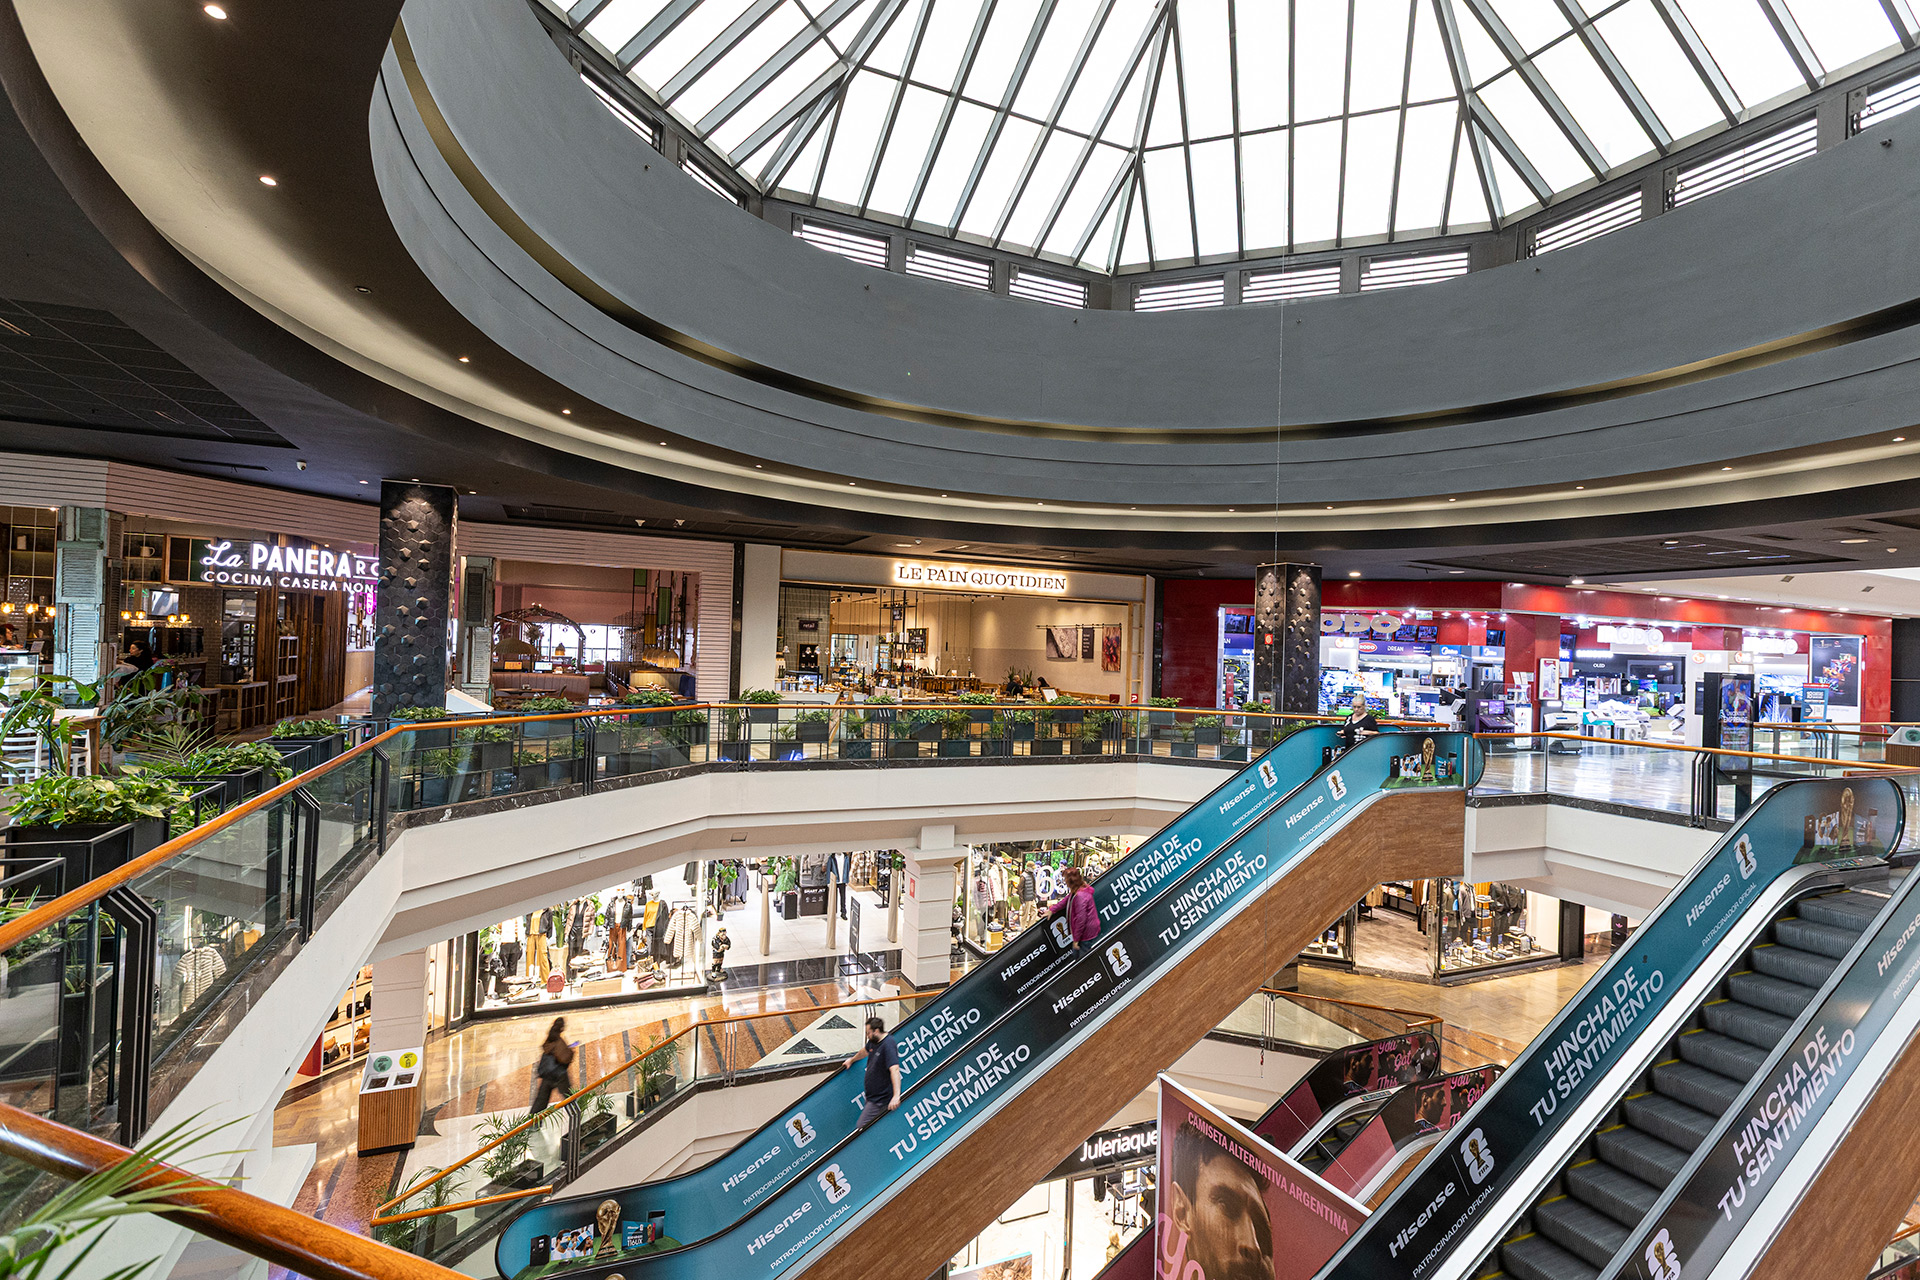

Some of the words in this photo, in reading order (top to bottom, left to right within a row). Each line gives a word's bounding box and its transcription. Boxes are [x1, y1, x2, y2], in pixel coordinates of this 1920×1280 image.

[201, 542, 244, 568] La
[251, 543, 351, 578] PANERA
[203, 571, 273, 587] COCINA
[280, 576, 338, 592] CASERA
[898, 566, 922, 580] LE
[927, 568, 968, 583] PAIN
[971, 572, 1067, 590] QUOTIDIEN
[1320, 614, 1401, 633] ODO
[1219, 784, 1256, 815] Hisense
[1285, 795, 1324, 829] Hisense
[1100, 900, 1121, 921] TU
[1119, 837, 1202, 907] SENTIMIENTO
[1110, 849, 1165, 896] HINCHA
[1161, 834, 1182, 856] DE
[1170, 867, 1228, 918] HINCHA
[1224, 850, 1247, 875] DE
[1158, 922, 1181, 946] TU
[1179, 854, 1267, 931] SENTIMIENTO
[1686, 873, 1731, 927] Hisense
[1701, 902, 1740, 947] PATROCINADOR
[1000, 944, 1047, 981] Hisense
[1877, 913, 1920, 977] Hisense
[1052, 972, 1102, 1014] Hisense
[1069, 992, 1112, 1028] PATROCINADOR
[1110, 977, 1132, 996] OFICIAL
[897, 1025, 933, 1058] CHA
[930, 1006, 956, 1032] DE
[1529, 1088, 1557, 1127] TU
[1556, 969, 1664, 1099] SENTIMIENTO
[1544, 995, 1616, 1081] HINCHA
[1613, 966, 1639, 1005] DE
[851, 1091, 866, 1111] T
[899, 1008, 981, 1080] NTIMIENTO
[904, 1064, 980, 1128] HINCHA
[975, 1042, 1003, 1072] DE
[889, 1132, 918, 1161] TU
[917, 1044, 1031, 1141] SENTIMIENTO
[1717, 1177, 1747, 1222] TU
[1746, 1028, 1856, 1187] SENTIMIENTO
[1732, 1061, 1807, 1166] HINCHA
[1803, 1025, 1830, 1068] DE
[722, 1146, 781, 1193] Hisense
[743, 1165, 792, 1206] PATROCINADOR
[791, 1148, 817, 1168] OFICIAL
[1079, 1130, 1158, 1164] Juleriaque
[1188, 1111, 1228, 1151] CAMISETA
[1228, 1140, 1288, 1193] ALTERNATIVA
[1289, 1182, 1349, 1236] ARGENTINA
[746, 1202, 813, 1256] Hisense
[770, 1223, 825, 1270] PATROCINADOR
[823, 1203, 851, 1226] OFICIAL
[1388, 1181, 1456, 1259] Hisense
[1412, 1212, 1468, 1278] PATROCINADOR
[1467, 1185, 1495, 1216] OFICIAL
